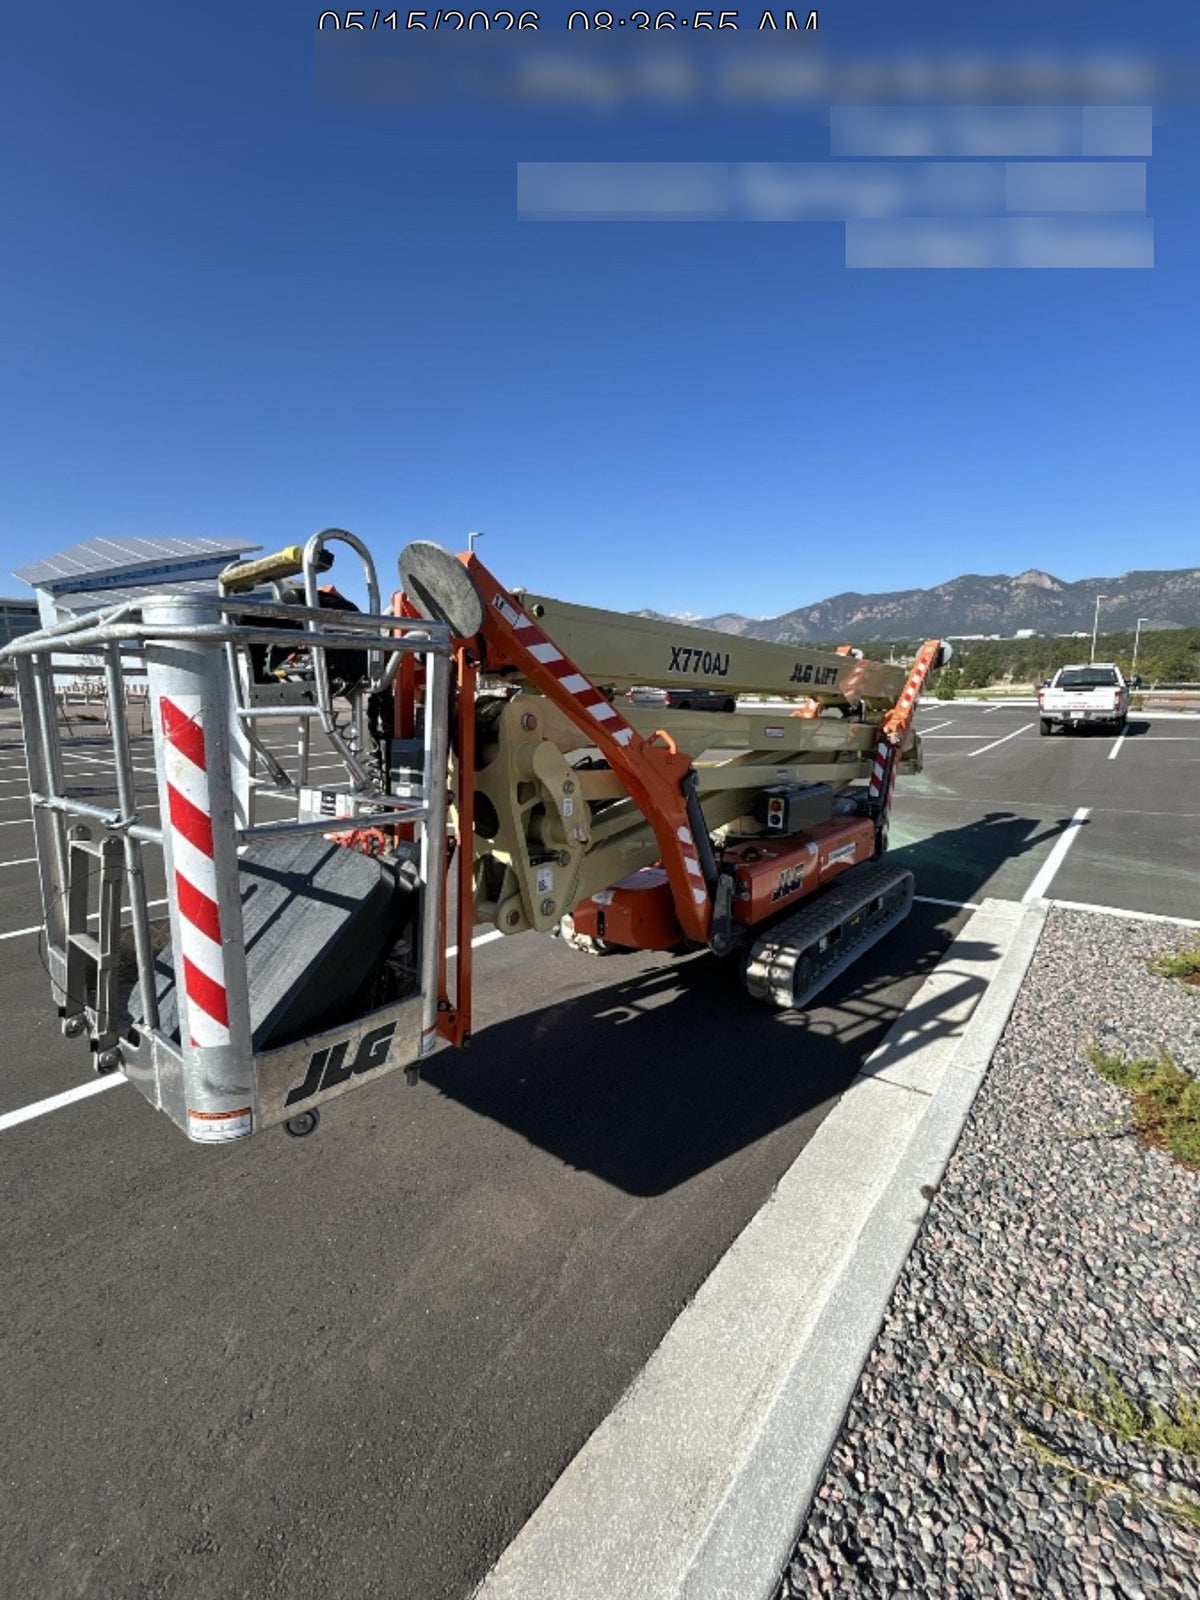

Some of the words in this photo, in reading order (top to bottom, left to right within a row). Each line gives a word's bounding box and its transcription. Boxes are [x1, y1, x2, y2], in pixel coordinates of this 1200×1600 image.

[668, 646, 730, 677] X770AJ
[790, 663, 813, 683] JLG
[814, 666, 839, 685] LIFT
[771, 862, 805, 904] JLG
[283, 1019, 399, 1109] JLG
